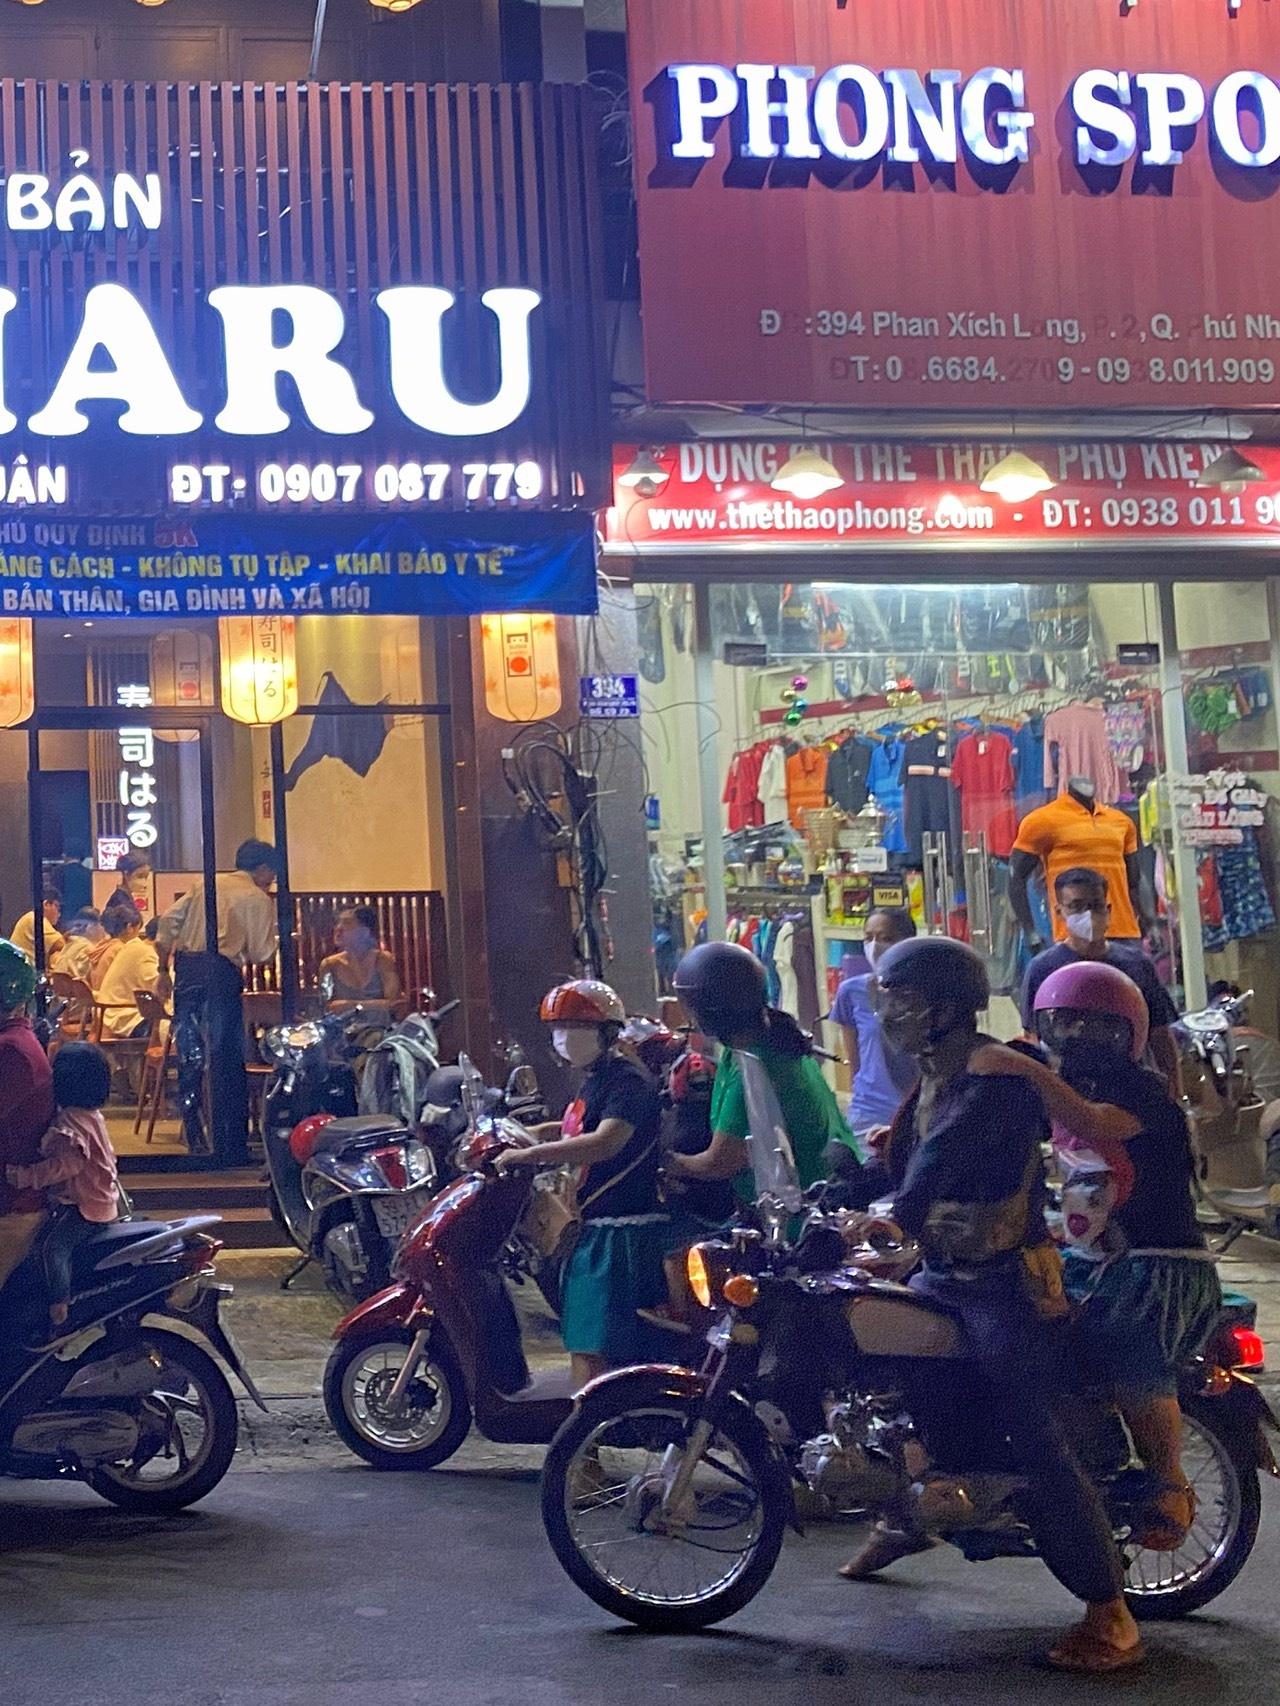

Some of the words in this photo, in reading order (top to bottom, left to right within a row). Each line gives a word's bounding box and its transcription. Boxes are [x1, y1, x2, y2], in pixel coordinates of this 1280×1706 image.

[667, 63, 1034, 166] PHONG
[7, 149, 161, 231] BẢN
[873, 311, 939, 337] Phan
[947, 311, 1006, 337] Xích
[260, 463, 362, 502] 0907
[374, 463, 450, 502] 087
[462, 461, 542, 500] 779
[679, 443, 778, 492] DỤNG
[1058, 443, 1128, 489] PHỤ
[648, 500, 993, 534] www.thethaophong.com
[1042, 498, 1091, 528] ĐT:
[1102, 497, 1178, 527] 0938
[1188, 496, 1245, 526] 011
[34, 523, 79, 547] QUY
[87, 523, 146, 550] ĐỊNH
[51, 552, 114, 579] CÁCH
[139, 552, 221, 578] KHÔNG
[230, 555, 258, 582] TỤ
[266, 551, 310, 583] TẬP
[336, 552, 391, 575] KHAI
[398, 550, 446, 575] BÁO
[454, 552, 468, 575] Y
[4, 582, 53, 611] BẢN
[60, 586, 130, 615] THÂN,
[138, 589, 178, 612] GIA
[186, 584, 246, 611] ĐÌNH
[253, 584, 285, 610] VÀ
[291, 582, 323, 609] XÃ
[331, 582, 370, 613] HỘI
[878, 891, 899, 900] VISA
